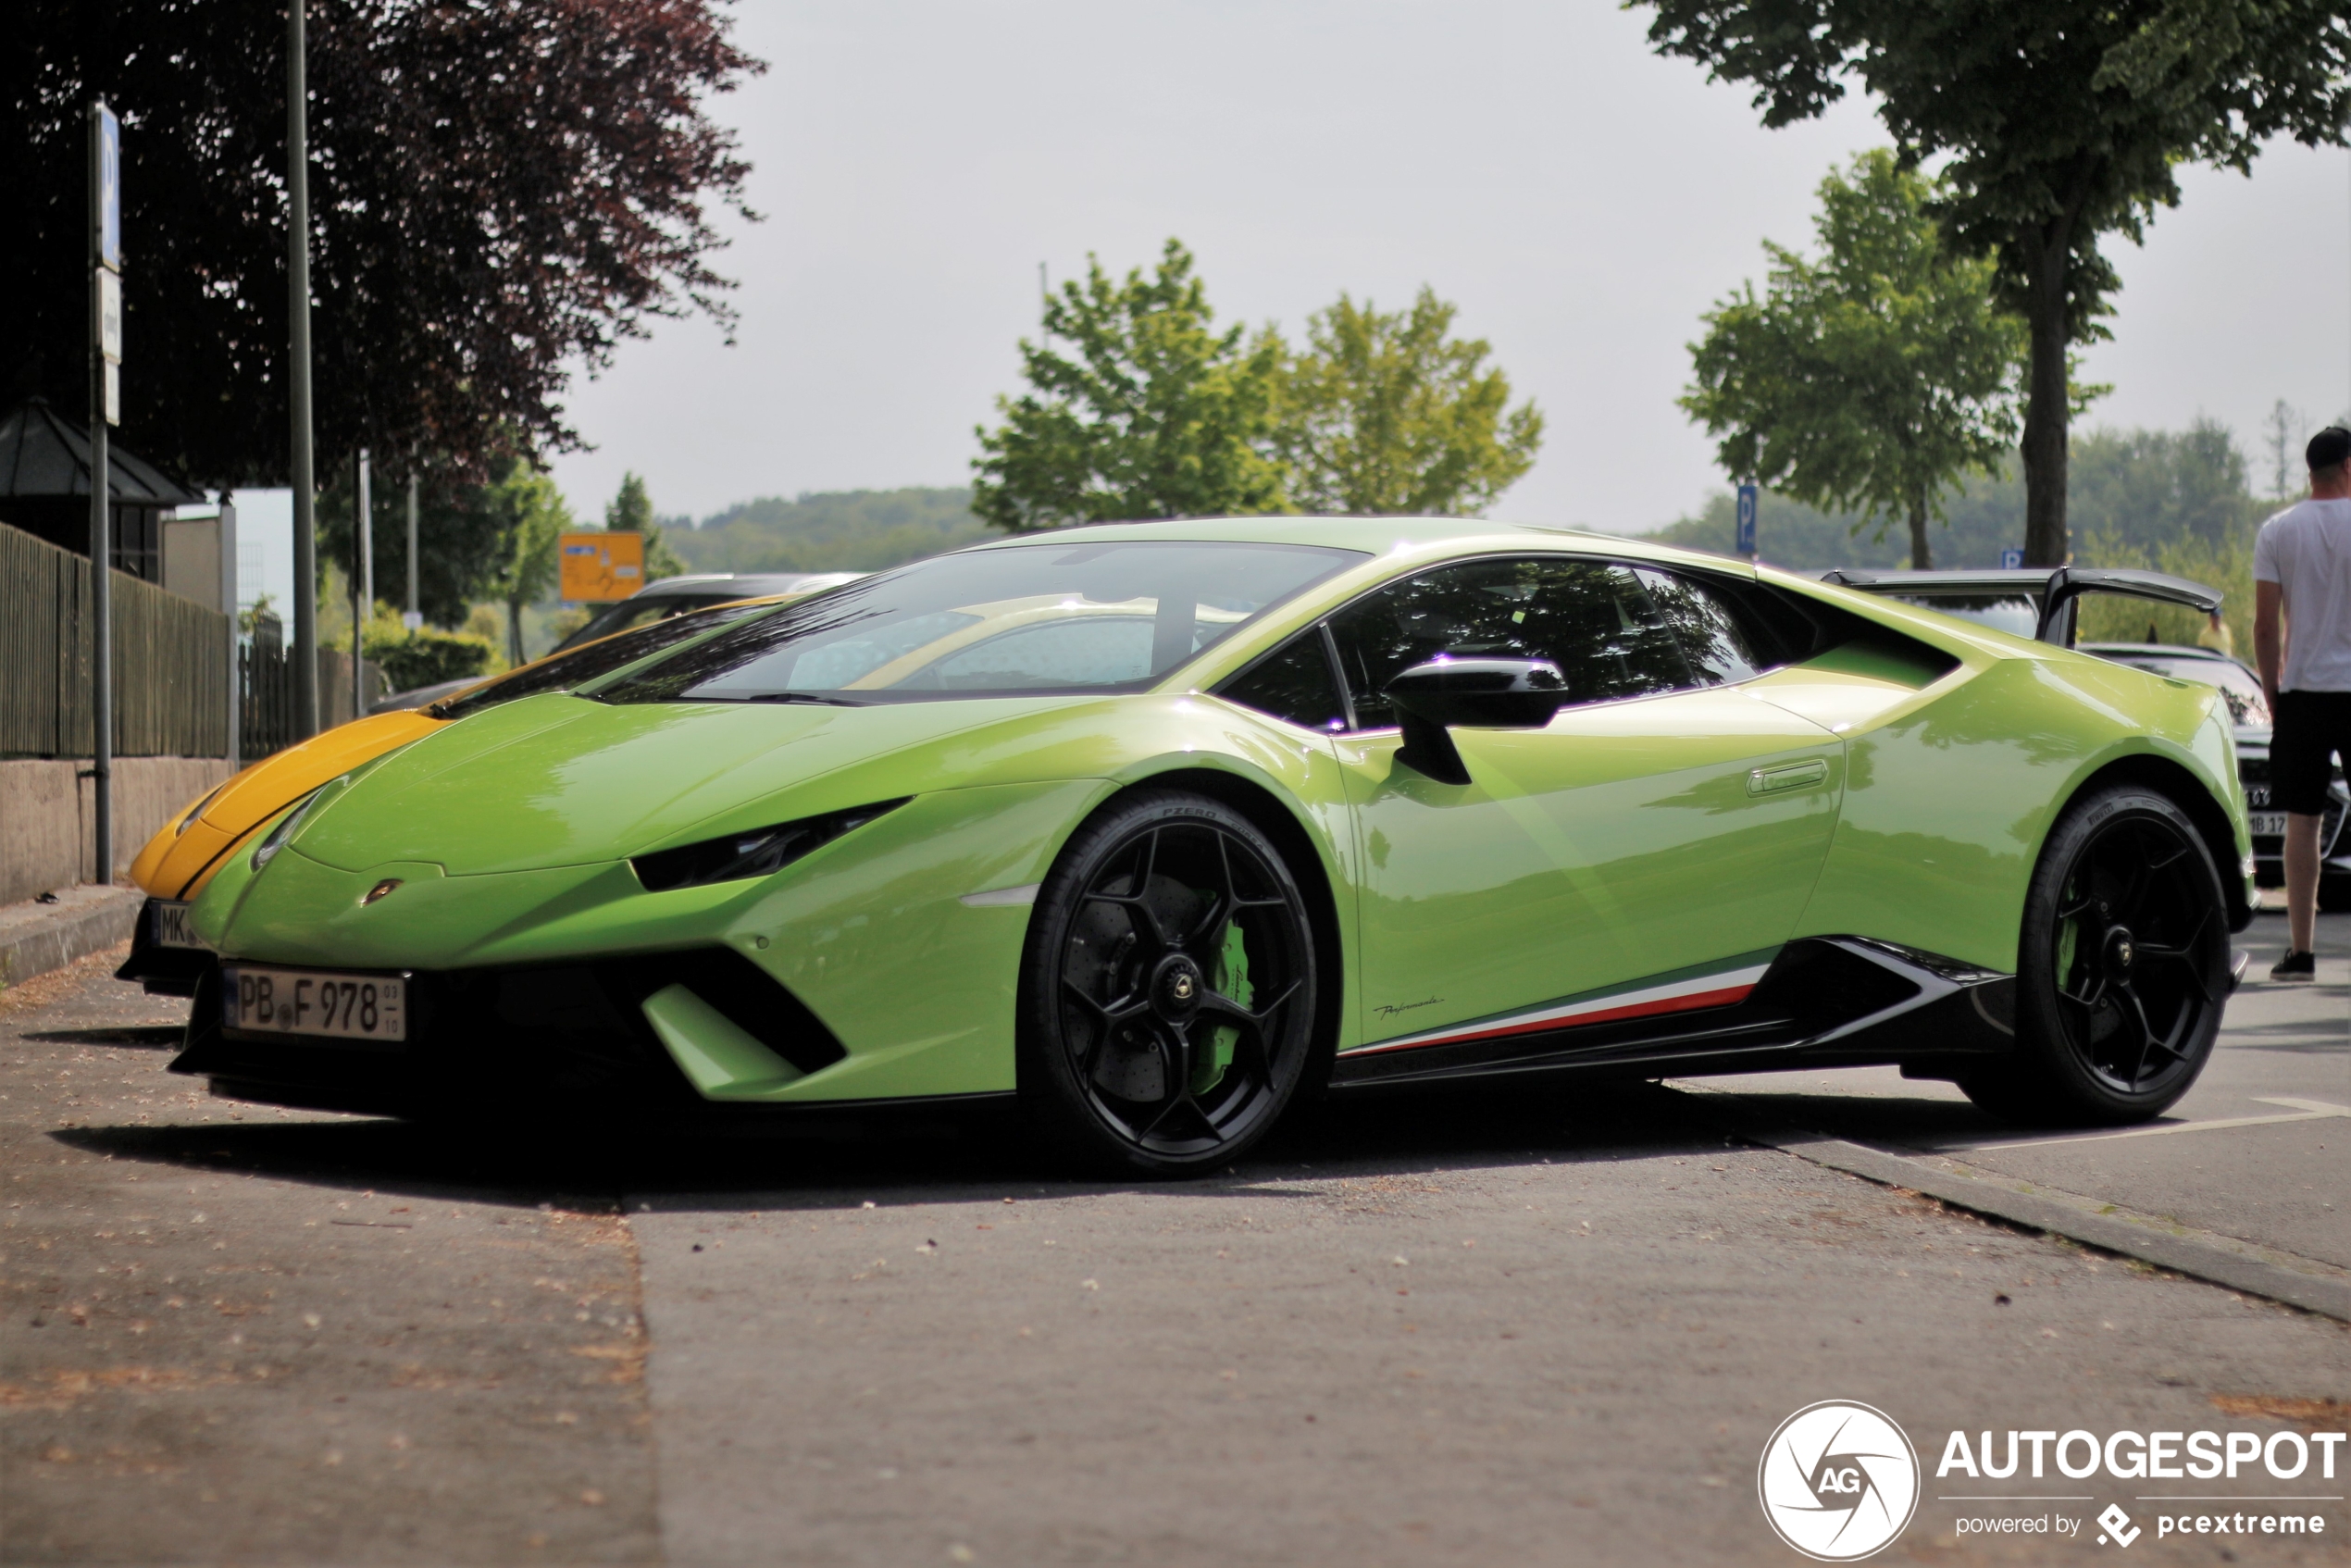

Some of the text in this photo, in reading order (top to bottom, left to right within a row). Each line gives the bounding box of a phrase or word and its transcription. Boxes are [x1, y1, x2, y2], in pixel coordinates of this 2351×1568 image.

[105, 131, 114, 243] P
[1741, 493, 1752, 544] P
[2270, 816, 2285, 833] 17
[162, 908, 186, 942] MK
[239, 975, 378, 1032] PB F 978
[384, 985, 398, 999] 03
[1373, 995, 1446, 1021] Performante
[385, 1019, 398, 1033] 10
